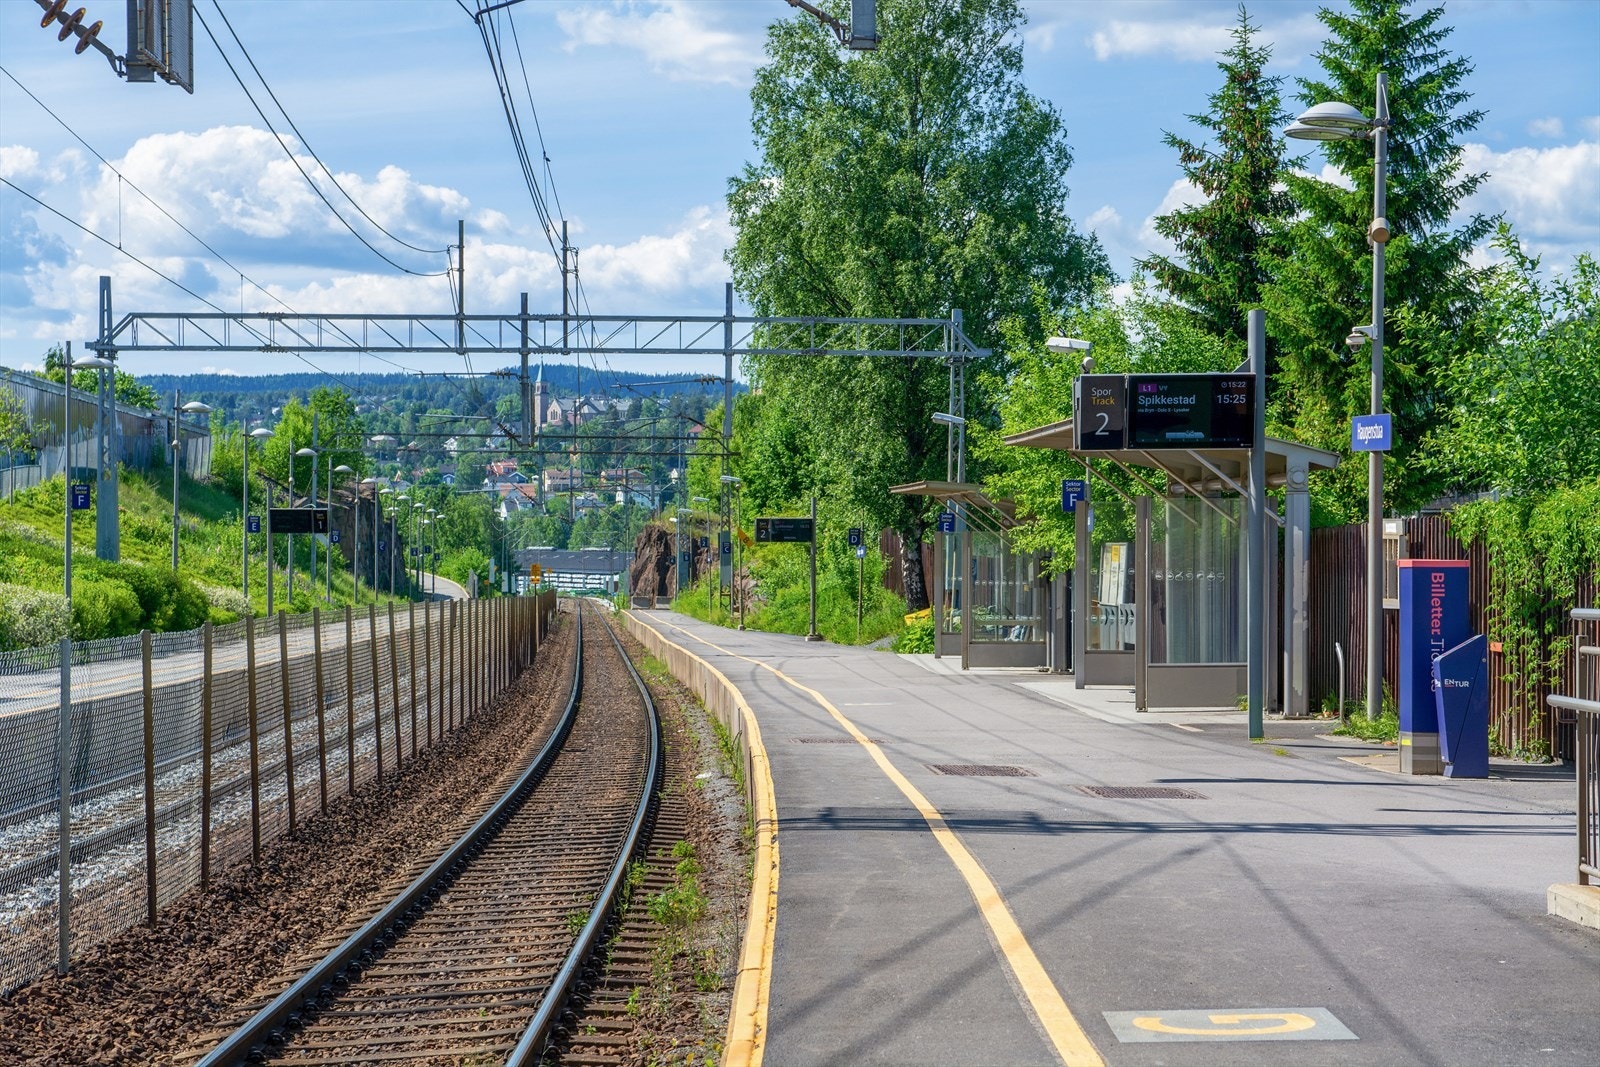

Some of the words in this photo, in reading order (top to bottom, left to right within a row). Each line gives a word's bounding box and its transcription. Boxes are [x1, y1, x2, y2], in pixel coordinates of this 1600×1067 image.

[1091, 387, 1112, 397] Spor
[1091, 396, 1115, 405] Track
[1138, 394, 1196, 406] Spikkestad
[1217, 394, 1246, 404] 15:25
[1095, 412, 1109, 435] 2
[78, 495, 85, 506] F
[1070, 493, 1077, 507] F
[251, 522, 257, 531] E
[318, 520, 322, 529] 1
[943, 522, 950, 533] E
[760, 529, 766, 538] 2
[851, 535, 858, 544] D
[1431, 572, 1446, 635] Billetter
[1444, 679, 1470, 688] ENTUR
